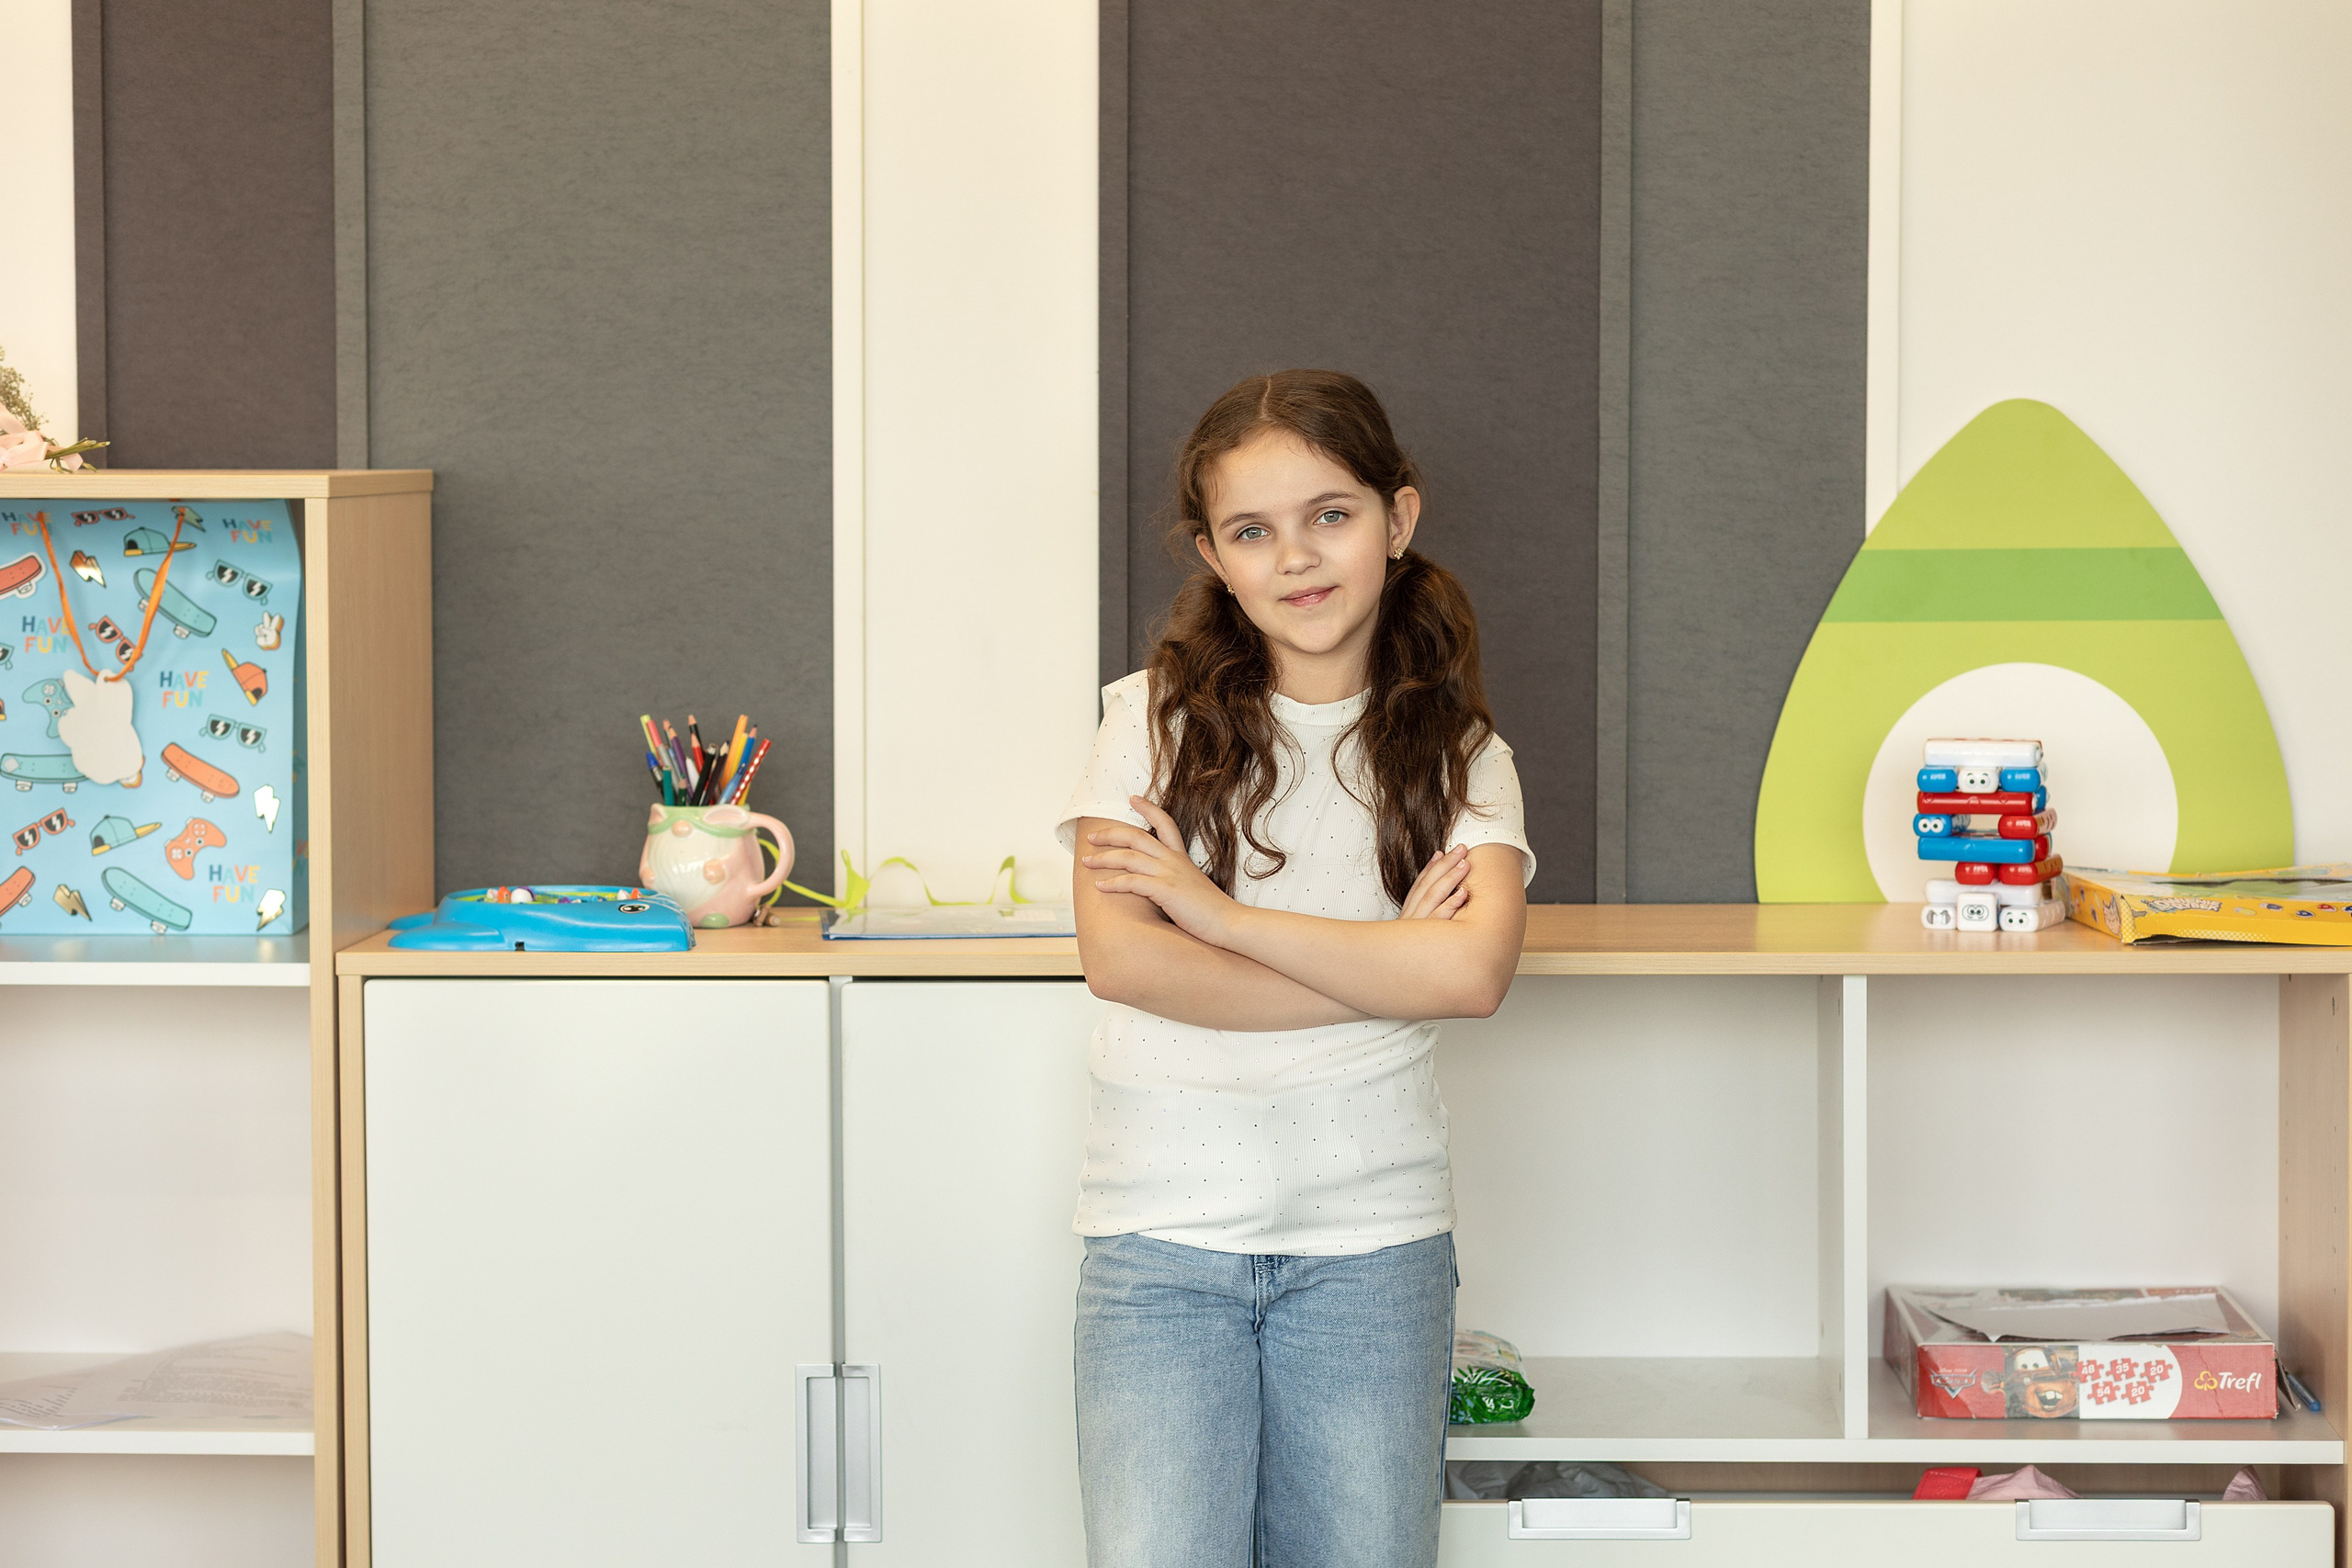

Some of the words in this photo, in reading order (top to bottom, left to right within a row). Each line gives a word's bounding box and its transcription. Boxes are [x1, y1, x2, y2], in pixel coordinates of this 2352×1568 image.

[222, 518, 273, 531] HAVE
[231, 529, 273, 543] FUN
[25, 636, 67, 653] FUN
[160, 671, 209, 690] HAVE
[163, 691, 203, 707] FUN
[209, 864, 260, 884] HAVE
[213, 885, 254, 903] FUN
[2081, 1364, 2096, 1375] 48
[2116, 1362, 2130, 1374] 35
[2150, 1365, 2164, 1376] 20
[2218, 1371, 2262, 1393] Trefl
[2097, 1386, 2110, 1397] 54
[2132, 1386, 2145, 1397] 20
